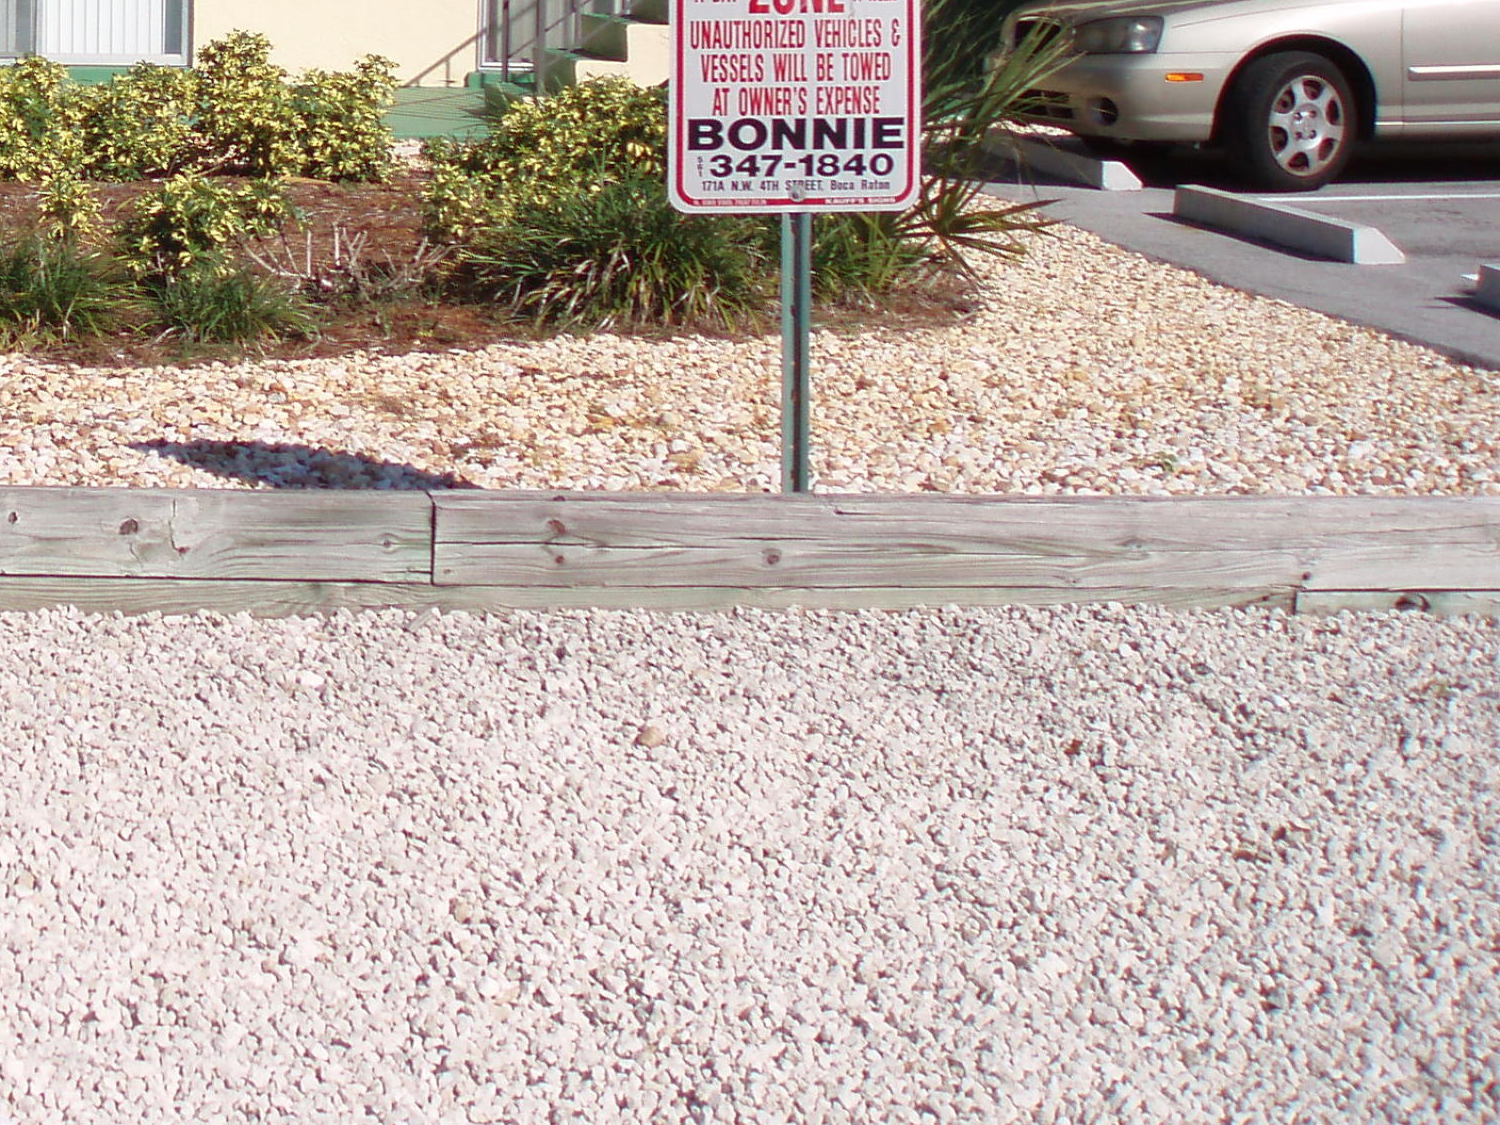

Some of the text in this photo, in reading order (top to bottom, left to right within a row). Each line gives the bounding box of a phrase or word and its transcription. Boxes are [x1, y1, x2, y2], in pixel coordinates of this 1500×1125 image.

[691, 19, 900, 49] UNAUTHORIZED VEHICLES &
[701, 53, 891, 82] VESSELS WILL BE TOWED
[713, 86, 880, 116] AT OWNER'S EXPENSE
[688, 117, 904, 150] BONNIE
[710, 154, 893, 178] 347-1840
[731, 181, 752, 191] N.W.
[760, 181, 779, 191] 4TH
[830, 180, 854, 190] Boca
[862, 180, 890, 190] Raton
